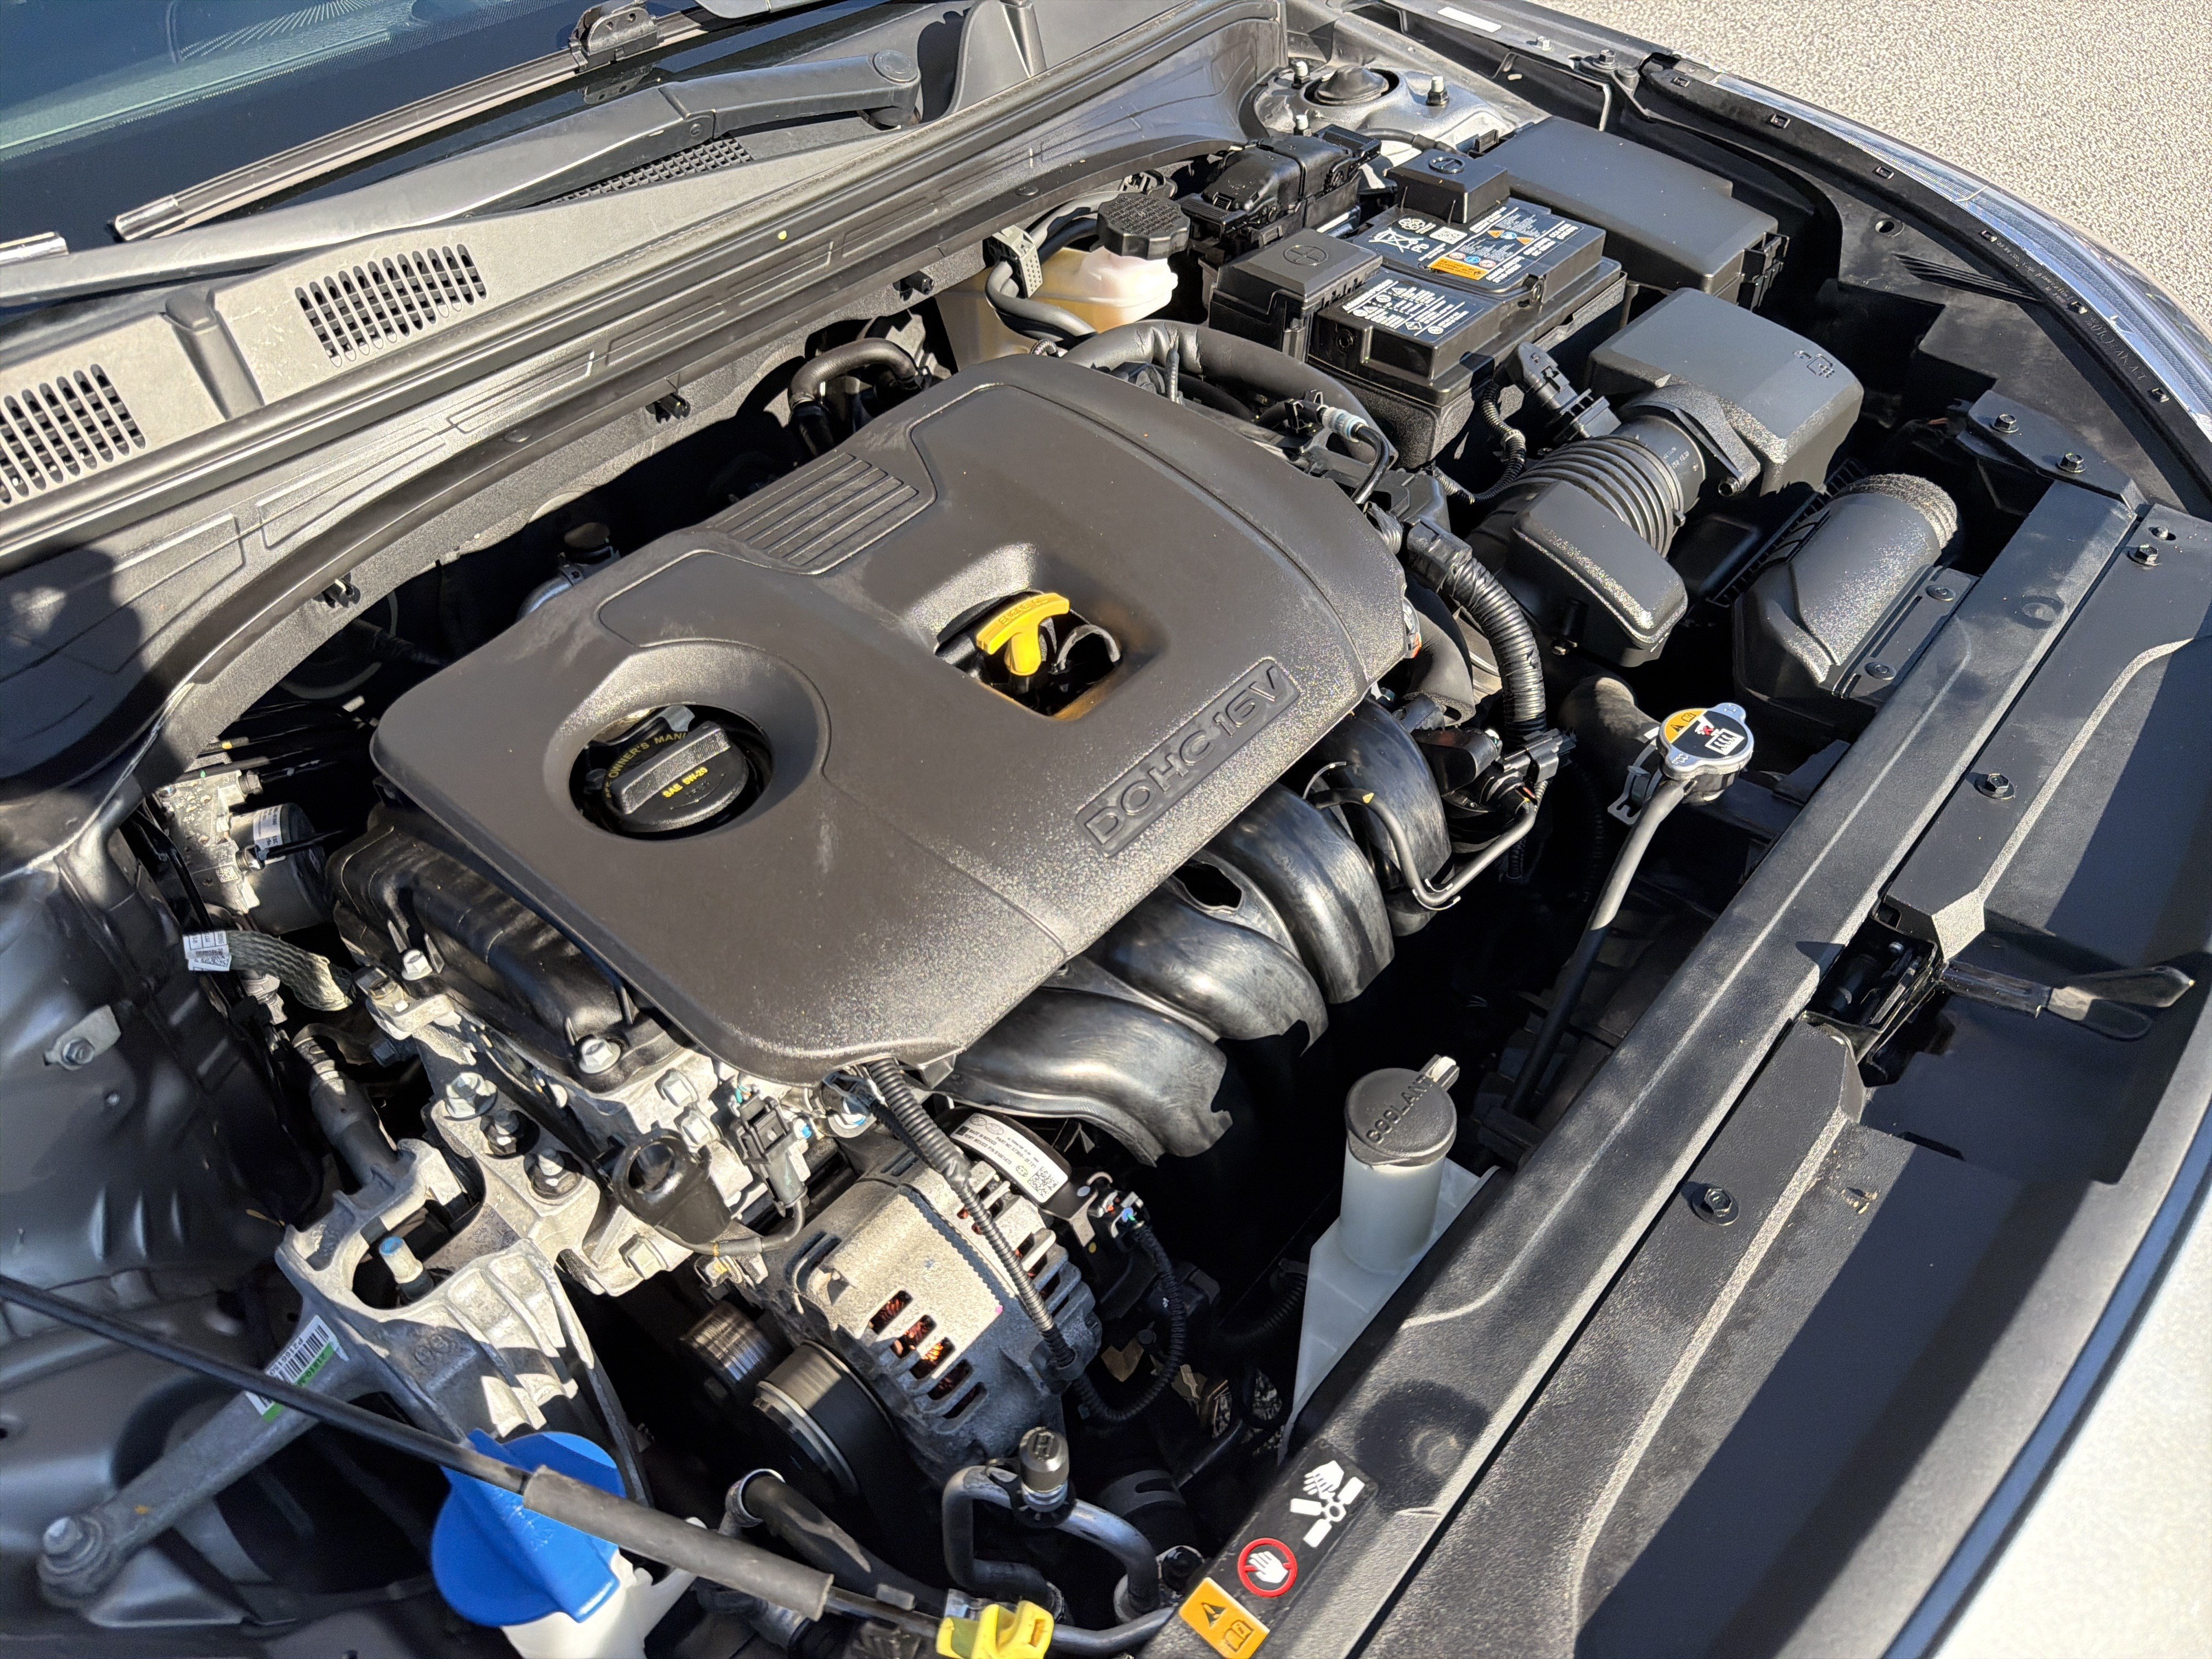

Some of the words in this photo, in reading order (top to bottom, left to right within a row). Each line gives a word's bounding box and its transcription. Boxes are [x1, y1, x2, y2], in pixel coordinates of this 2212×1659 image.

[608, 742, 650, 778] OWNER'S
[1084, 730, 1211, 845] DOHC
[1215, 665, 1279, 739] 16V
[661, 783, 684, 798] SAE
[682, 766, 708, 786] 5W-20
[1365, 1074, 1433, 1144] COOLANT
[974, 1138, 989, 1148] MEXICO
[983, 1135, 997, 1146] MEXICO
